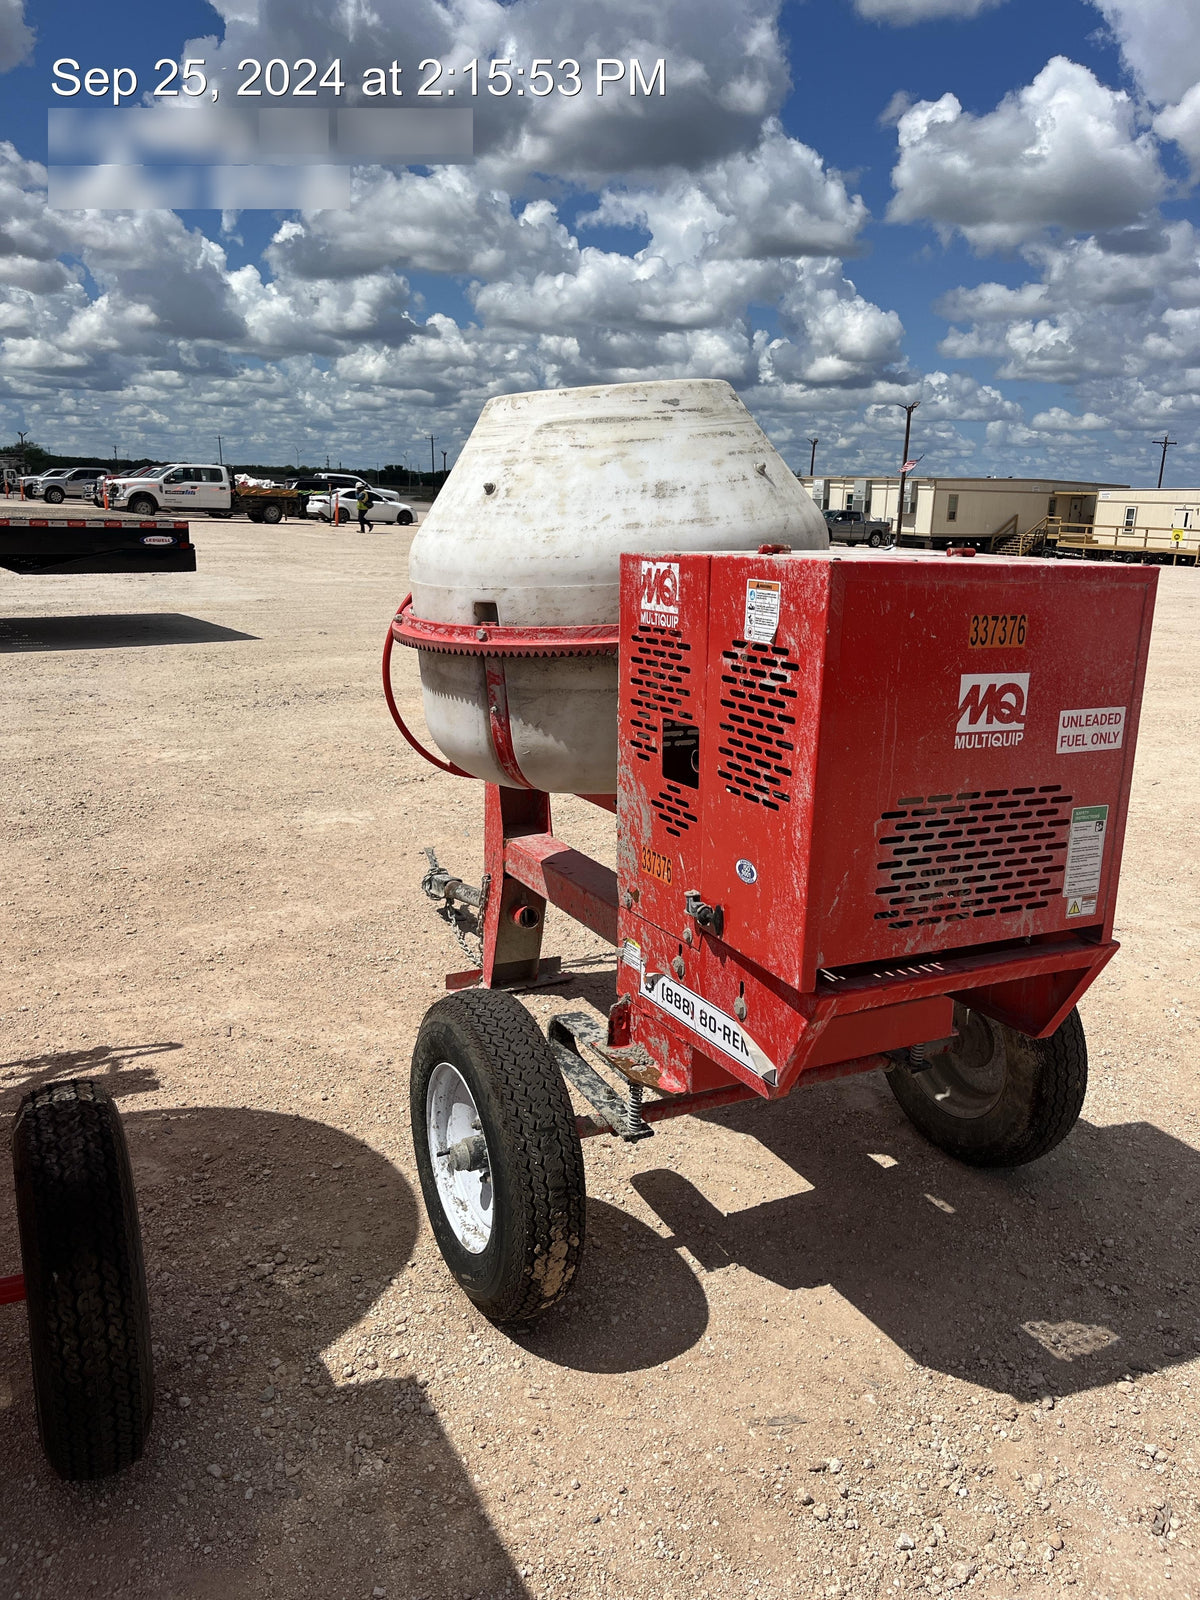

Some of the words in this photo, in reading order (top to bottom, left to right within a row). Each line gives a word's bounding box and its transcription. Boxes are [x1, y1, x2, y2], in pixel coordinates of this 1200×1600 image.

[640, 568, 679, 607] MQ
[641, 611, 679, 628] MULTIQUIP
[970, 614, 1027, 646] 337376
[957, 682, 1027, 726] MQ
[1061, 712, 1122, 729] UNLEADED
[954, 732, 1024, 749] MULTIQUIP
[1060, 735, 1088, 748] FUEL
[1091, 730, 1121, 746] ONLY
[641, 846, 672, 883] 337376
[661, 982, 695, 1020] (888)
